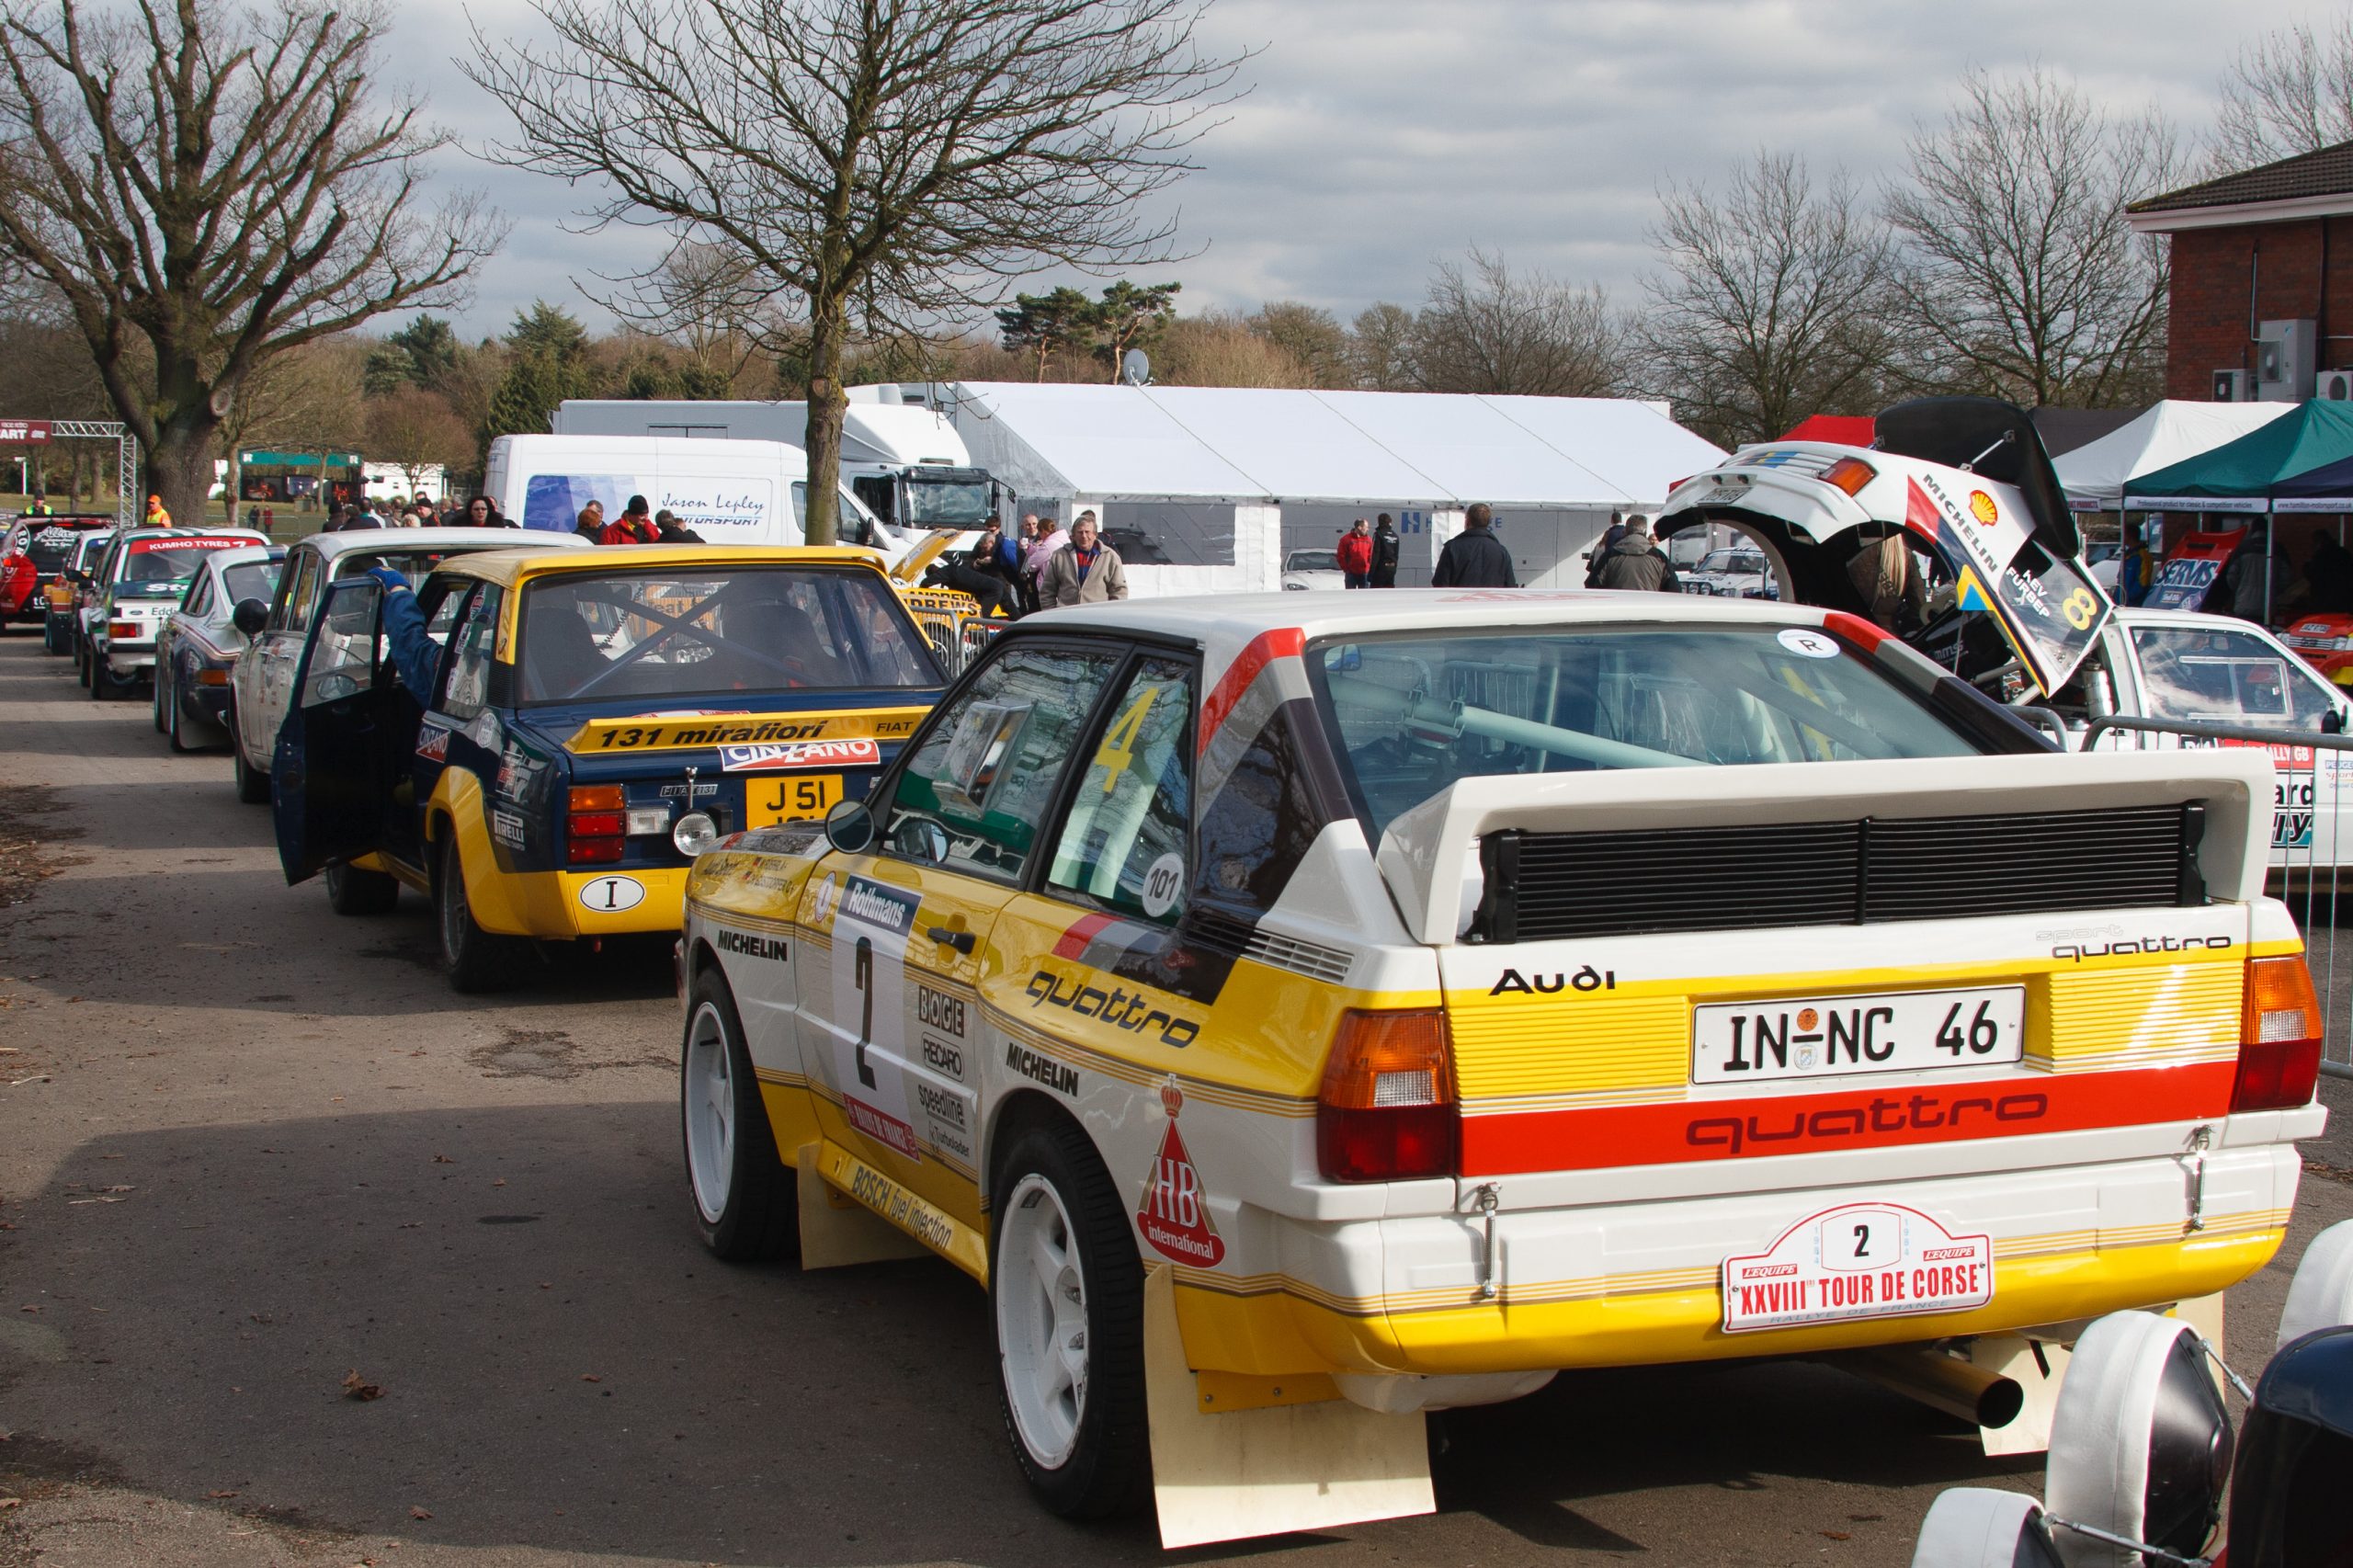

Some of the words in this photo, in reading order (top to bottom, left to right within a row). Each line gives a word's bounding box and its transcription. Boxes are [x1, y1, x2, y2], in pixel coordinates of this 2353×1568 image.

[662, 493, 709, 507] Jason
[1923, 473, 1999, 573] MICHELIN
[149, 540, 193, 551] KUMHO
[194, 540, 230, 549] TYRES
[2063, 587, 2097, 631] 8
[1798, 639, 1824, 652] R
[419, 727, 449, 754] CINZANO
[602, 728, 663, 747] 131
[673, 721, 827, 744] mirafiori
[876, 722, 913, 733] FIAT
[1094, 687, 1159, 793] 4
[728, 740, 871, 764] CINZANO
[2294, 747, 2310, 762] GB
[767, 782, 785, 811] J
[494, 810, 525, 843] PIRELLI
[605, 881, 618, 908] I
[1149, 868, 1179, 902] 101
[847, 882, 906, 928] Rothmans
[718, 929, 788, 962] MICHELIN
[2036, 924, 2124, 944] sport
[2052, 936, 2232, 963] quattro
[1490, 965, 1616, 996] Audi
[920, 987, 963, 1035] BOGE
[1025, 971, 1200, 1048] quattro
[1936, 999, 1997, 1057] 46
[923, 1038, 963, 1076] RECARO
[1006, 1042, 1080, 1097] MICHELIN
[918, 1084, 964, 1125] speedline
[1687, 1092, 2048, 1154] quattro
[1154, 1153, 1199, 1229] HB
[852, 1165, 892, 1215] BOSCH
[890, 1187, 910, 1222] fuel
[908, 1199, 952, 1251] injection
[1147, 1221, 1214, 1260] international
[1853, 1224, 1870, 1257] 2
[1924, 1246, 1974, 1261] L'EQUIPE
[1744, 1265, 1797, 1278] L'EQUIPE
[1819, 1274, 1874, 1308] TOUR
[1881, 1270, 1905, 1302] DE
[1913, 1264, 1979, 1300] CORSE
[1768, 1311, 1837, 1324] RALLYE
[1846, 1307, 1870, 1316] DE
[1880, 1300, 1951, 1312] FRANCE
